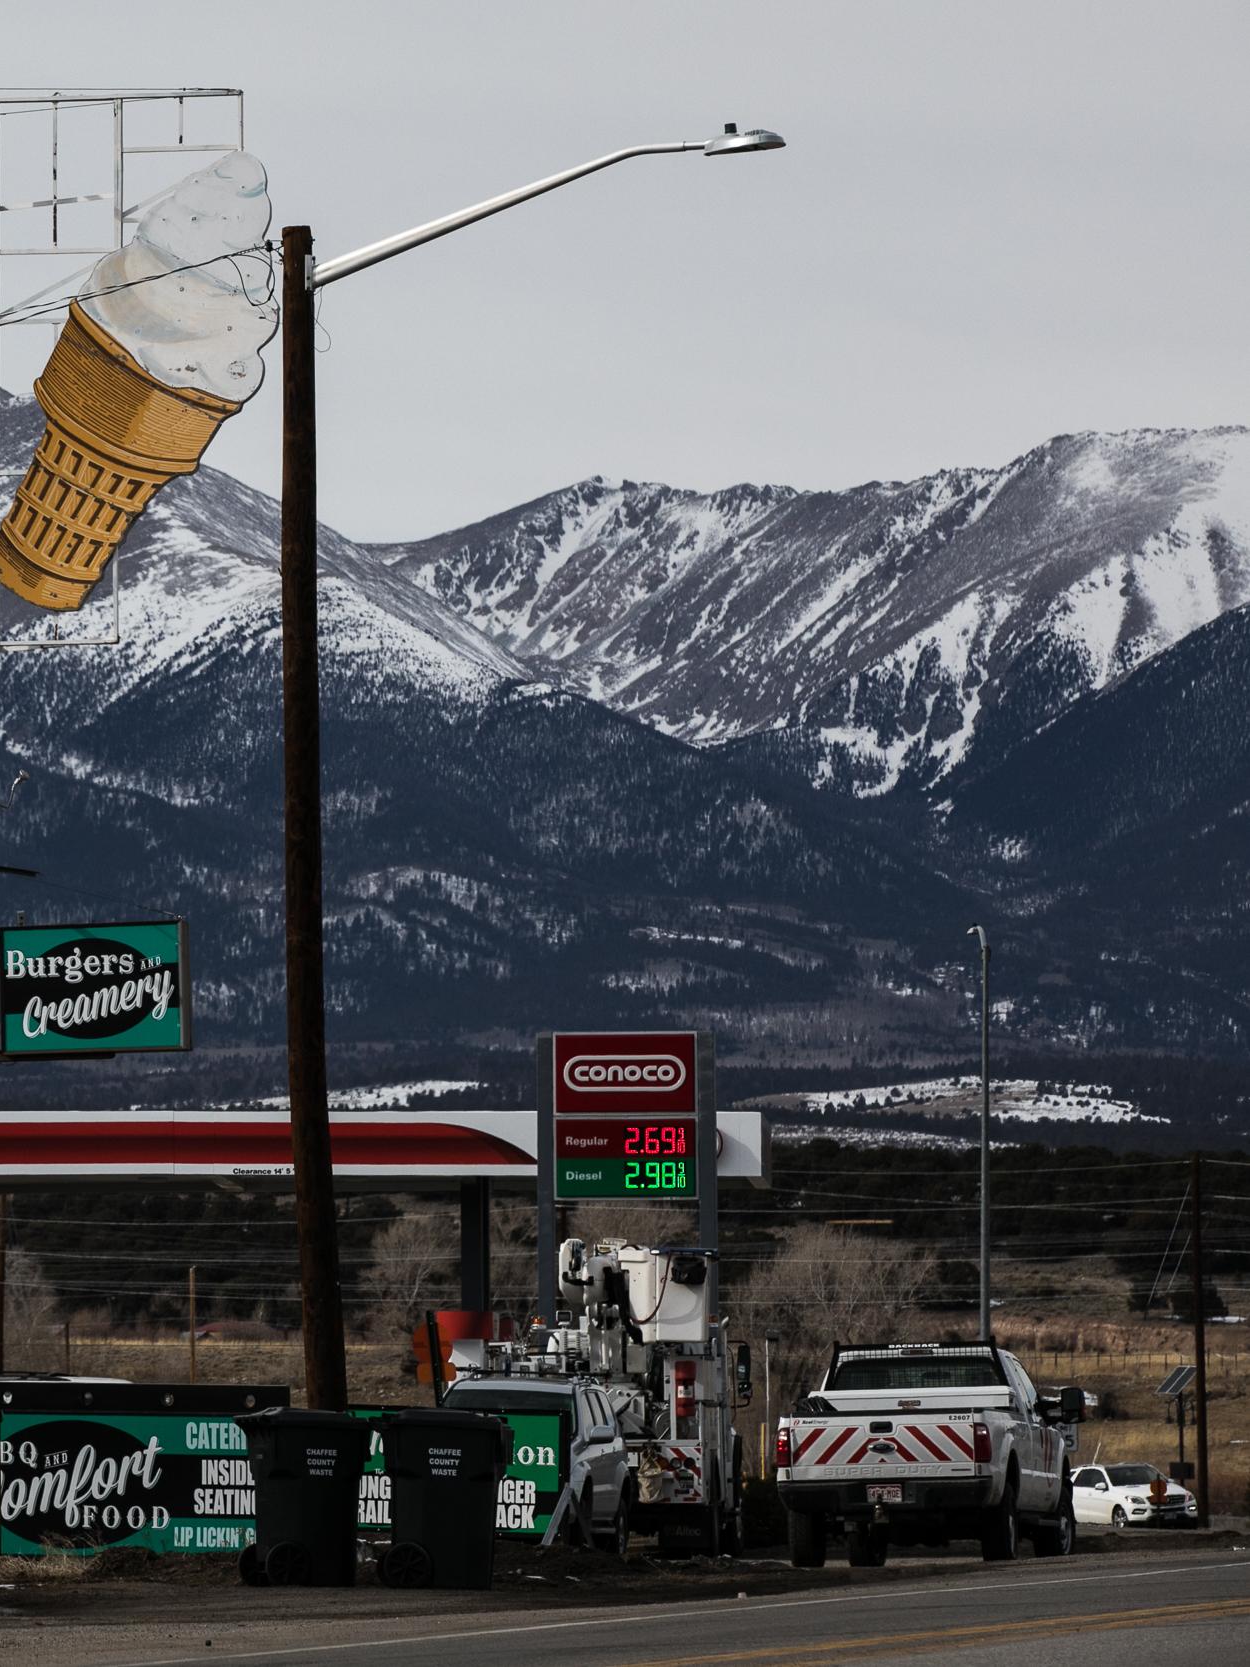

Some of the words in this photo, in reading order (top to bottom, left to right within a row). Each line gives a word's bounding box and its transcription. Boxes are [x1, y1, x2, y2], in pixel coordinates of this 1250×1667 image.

[6, 947, 134, 983] Burgers
[140, 955, 162, 971] AND
[23, 970, 174, 1038] Creamery
[565, 1136, 608, 1148] Regular
[625, 1126, 676, 1154] 2.69
[566, 1170, 602, 1180] Diesel
[625, 1162, 676, 1189] 2.98
[186, 1421, 247, 1450] CATERI
[44, 1451, 69, 1467] AND
[306, 1448, 338, 1456] CHAFFEE
[307, 1458, 336, 1466] COUNTY
[428, 1448, 462, 1456] CHAFFEE
[429, 1458, 460, 1466] COUNTY
[514, 1445, 557, 1466] on
[309, 1468, 333, 1476] WASTE
[431, 1468, 457, 1477] WASTE
[825, 1467, 884, 1477] SUPER
[896, 1465, 943, 1475] DUTY
[358, 1475, 392, 1500] UNG
[82, 1505, 170, 1529] FOOD
[357, 1499, 392, 1524] RAIL
[495, 1504, 535, 1529] ACK
[174, 1526, 193, 1547] LIP
